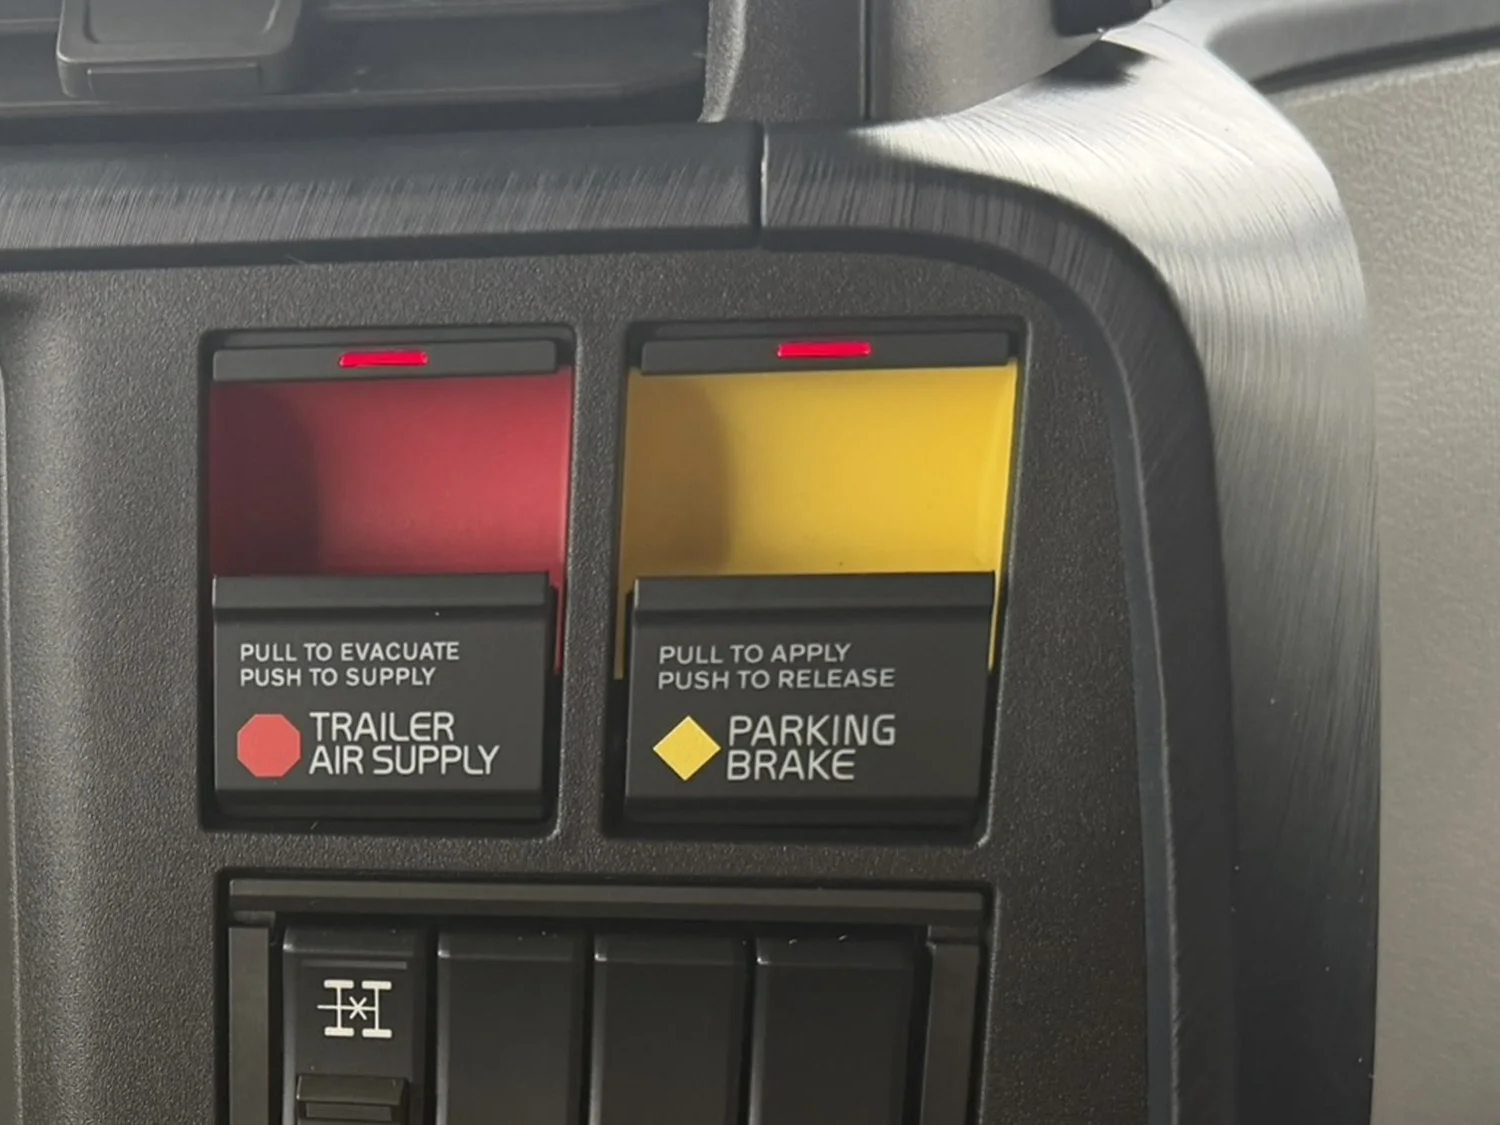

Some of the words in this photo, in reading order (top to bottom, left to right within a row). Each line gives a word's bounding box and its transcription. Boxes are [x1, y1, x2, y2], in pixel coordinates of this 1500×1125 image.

[241, 644, 296, 661] PULL
[304, 643, 332, 661] TO
[341, 642, 459, 661] EVACUATE
[660, 646, 722, 664] PULL
[730, 644, 763, 663] TO
[771, 644, 850, 662] APPLY
[241, 668, 301, 686] PUSH
[309, 668, 337, 686] TO
[346, 667, 435, 686] SUPPLY
[659, 671, 728, 690] PUSH
[737, 670, 770, 688] TO
[779, 669, 894, 688] RELEASE
[310, 712, 454, 741] TRAILER
[729, 714, 896, 746] PARKING
[309, 745, 363, 774] AIR
[373, 745, 499, 774] SUPPLY
[727, 749, 855, 780] BRAKE
